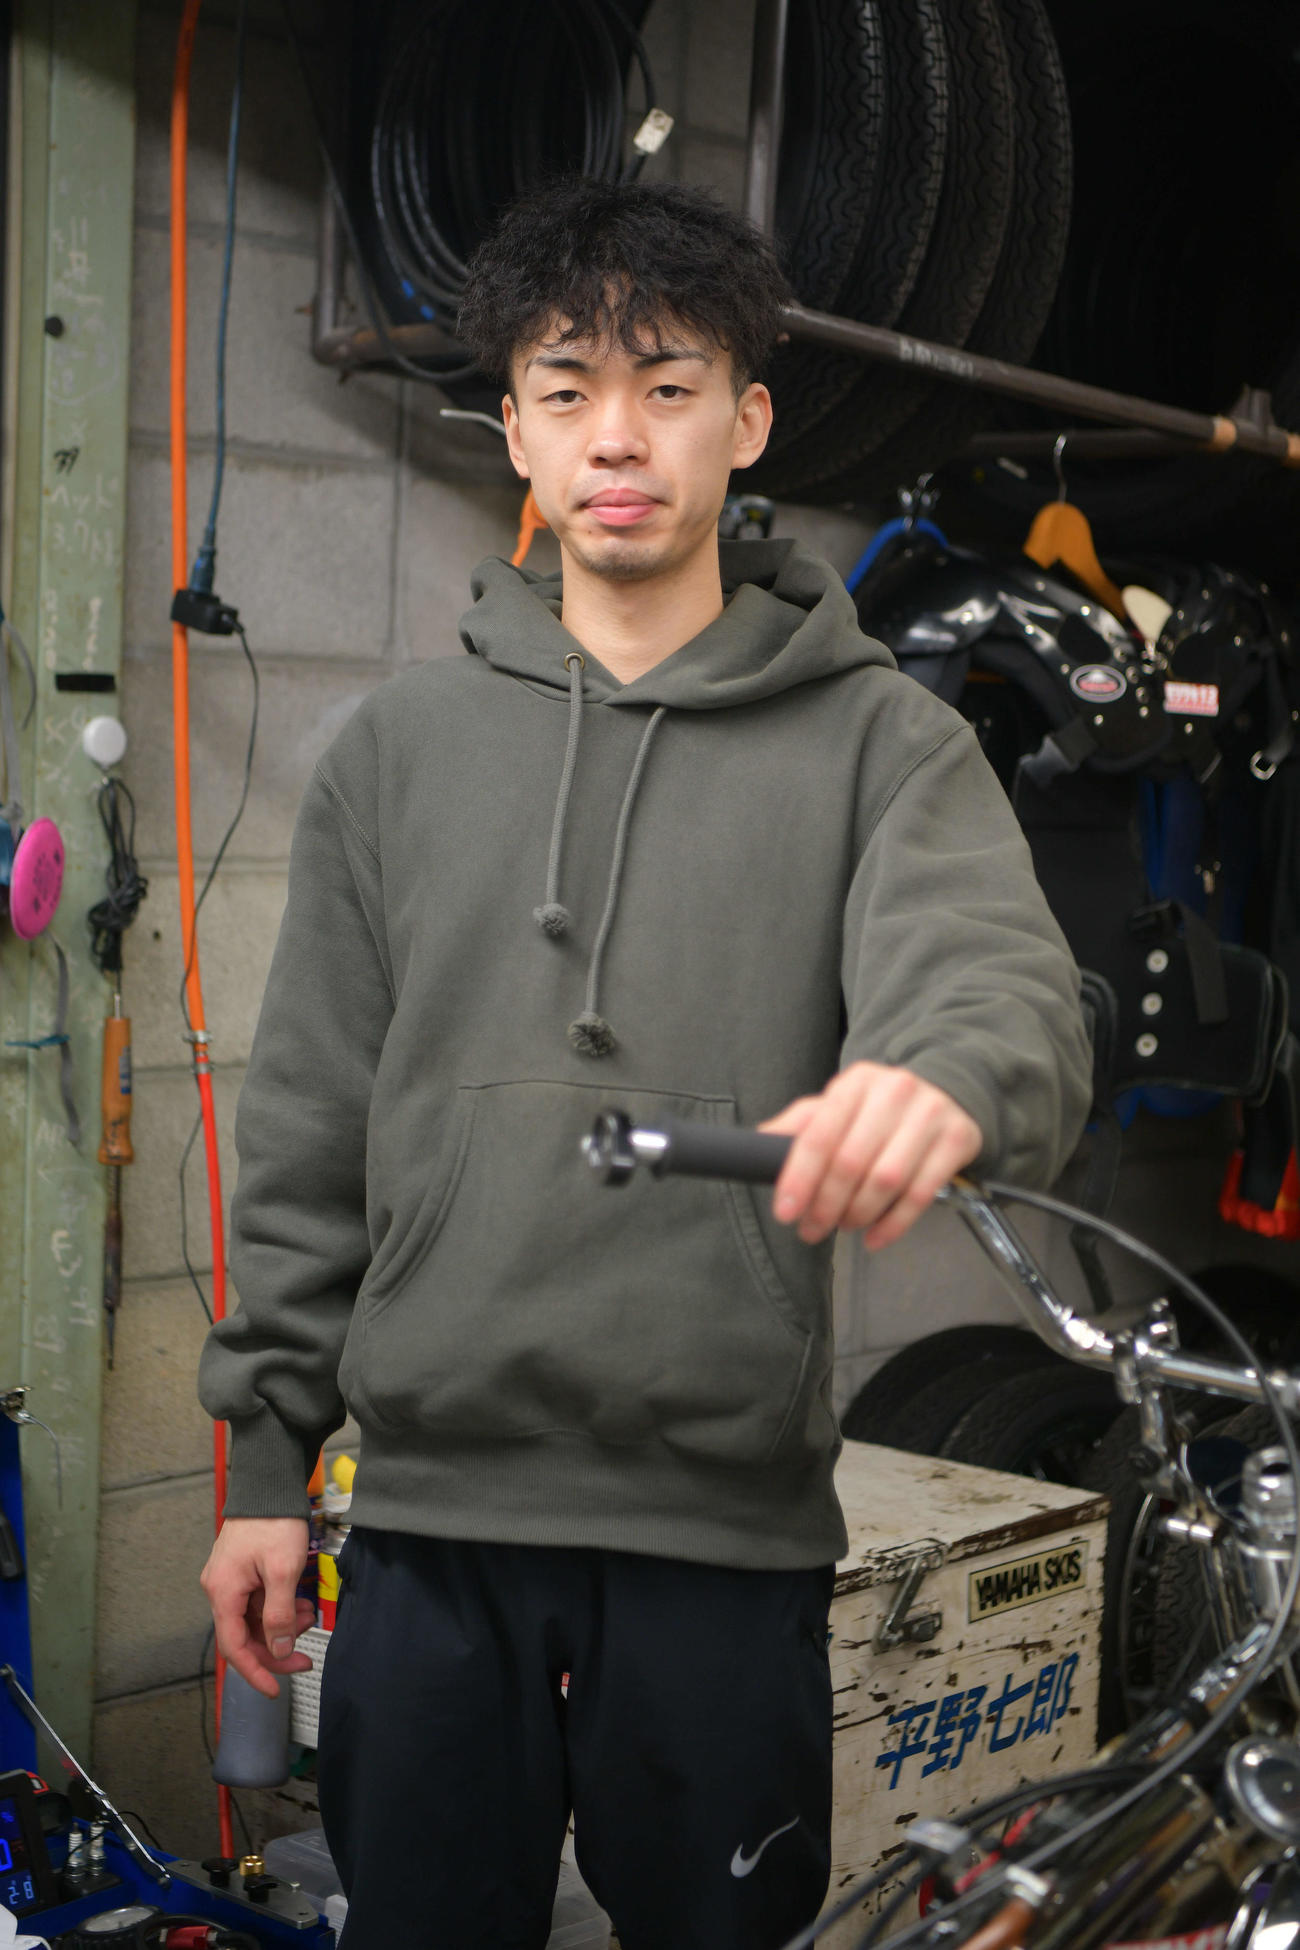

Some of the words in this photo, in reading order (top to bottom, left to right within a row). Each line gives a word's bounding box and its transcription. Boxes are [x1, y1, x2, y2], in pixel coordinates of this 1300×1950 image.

[976, 1561, 1041, 1611] YAMAHA
[874, 1651, 1080, 1791] 平野七郎
